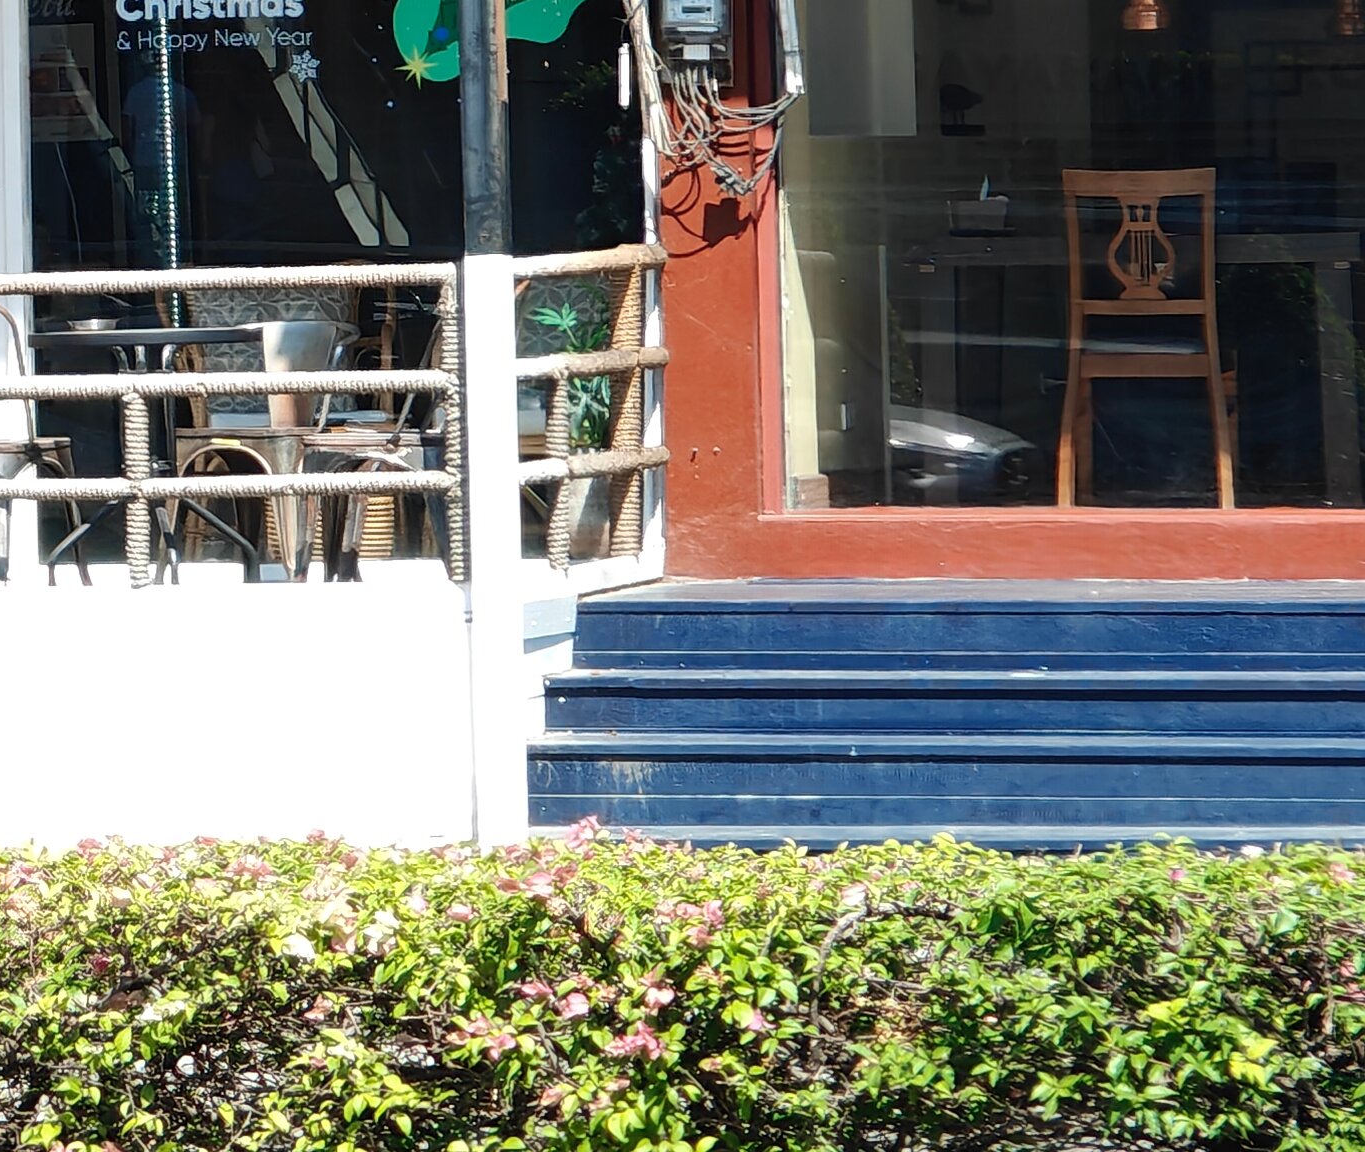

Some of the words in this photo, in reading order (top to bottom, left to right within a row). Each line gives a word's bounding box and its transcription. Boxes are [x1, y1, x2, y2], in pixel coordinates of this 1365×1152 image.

[116, 30, 131, 50] &
[138, 30, 208, 53] Happy
[215, 29, 260, 47] New
[266, 27, 314, 46] Year
